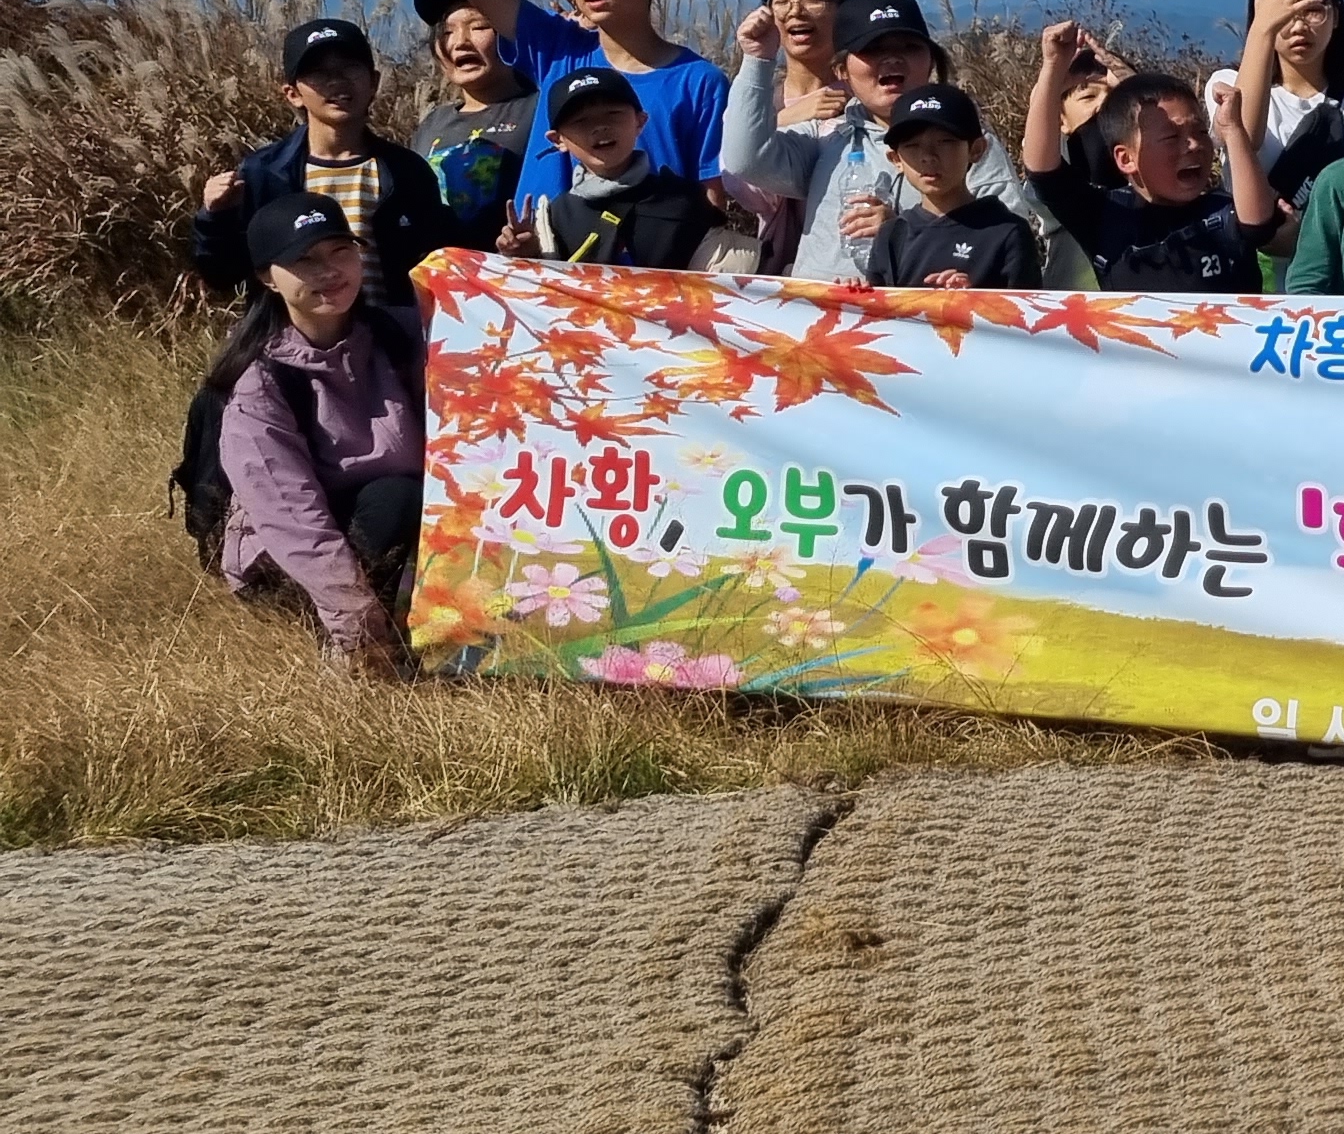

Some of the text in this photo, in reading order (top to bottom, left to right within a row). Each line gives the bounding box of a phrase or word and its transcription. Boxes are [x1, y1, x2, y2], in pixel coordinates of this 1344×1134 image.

[1201, 254, 1221, 277] 23
[500, 446, 685, 553] 차황,
[715, 467, 917, 558] 오부가
[941, 479, 1268, 598] 함께하는
